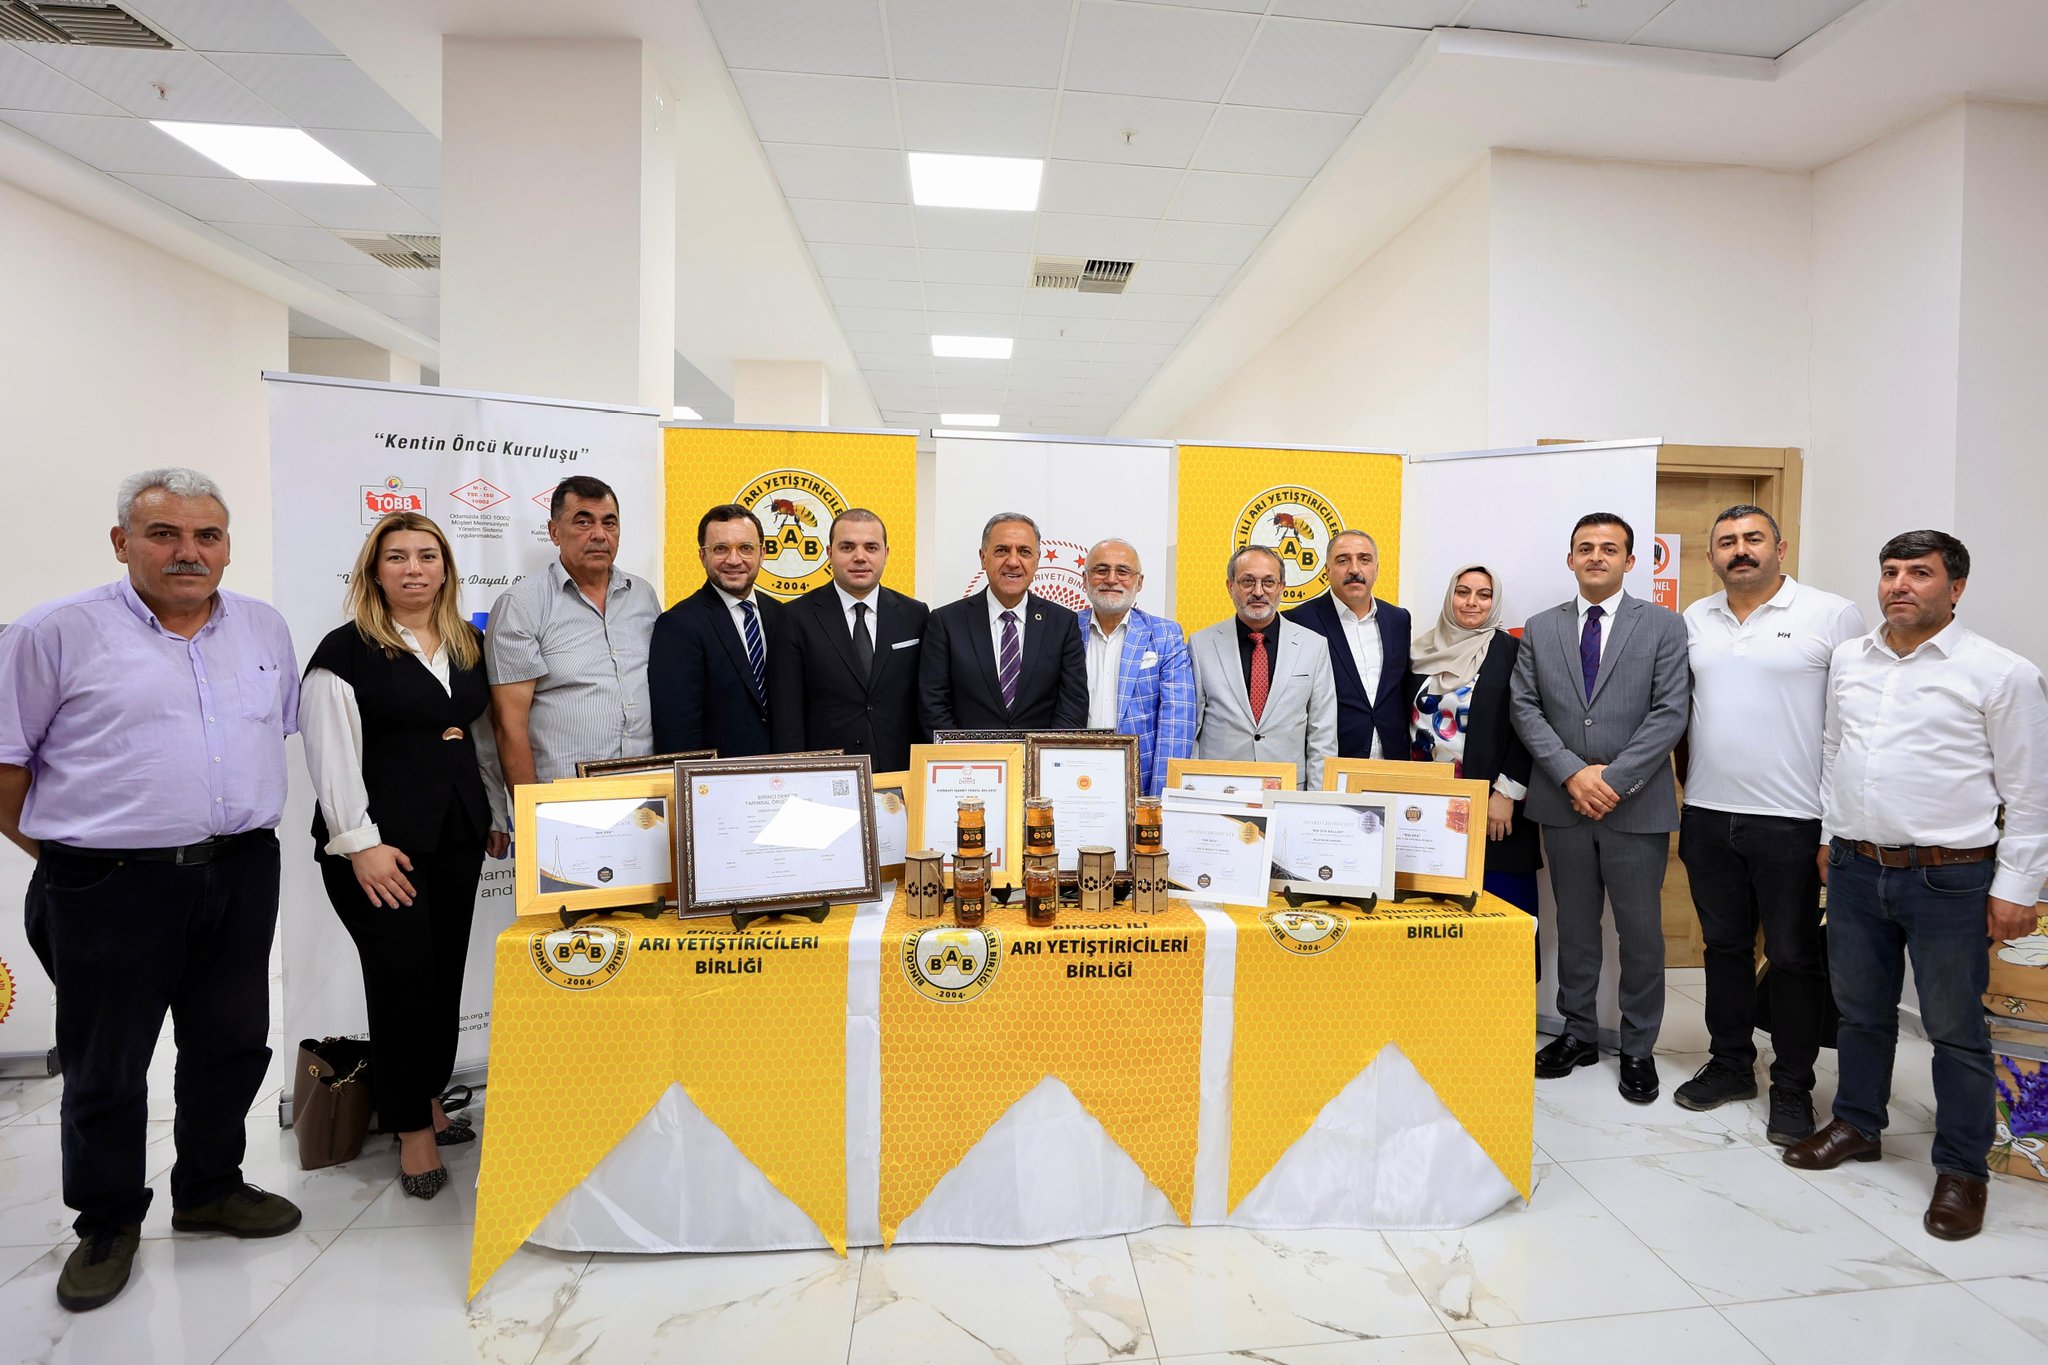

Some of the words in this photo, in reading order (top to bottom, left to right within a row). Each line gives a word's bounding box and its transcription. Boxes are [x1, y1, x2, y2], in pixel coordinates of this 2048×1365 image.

[374, 432, 446, 451] “Kentin
[452, 434, 497, 453] Öncü
[502, 441, 589, 463] Kuruluşu”
[375, 497, 412, 510] TOBB
[743, 485, 763, 506] ARI
[763, 473, 843, 517] YETİŞTİRİCİLE
[1249, 500, 1267, 519] ARI
[1267, 489, 1340, 537] YETİŞTİRİCİLER
[1237, 519, 1252, 535] İLİ
[765, 529, 818, 555] BAB
[1276, 541, 1314, 565] AB
[468, 574, 508, 587] Dayalı
[1034, 571, 1065, 582] RİYETİ
[1283, 590, 1303, 598] 004
[481, 884, 513, 898] and
[1407, 923, 1463, 939] BİRLİĞİ
[559, 938, 602, 959] BAB
[638, 938, 671, 951] ARI
[677, 935, 819, 954] YETİŞTİRİCİLERİ
[1010, 941, 1042, 956] ARI
[1047, 936, 1188, 957] YETİŞTİRİCİLERİ
[532, 937, 553, 974] BİNGÖL
[930, 950, 973, 971] BAB
[695, 957, 762, 975] BİRLİĞİ
[905, 950, 926, 987] BİNGÖL
[976, 951, 999, 988] BİRLİĞİ
[1066, 961, 1133, 978] BİRLİĞİ
[459, 1011, 490, 1021] so.org.tr
[458, 1022, 489, 1032] so.org.tr
